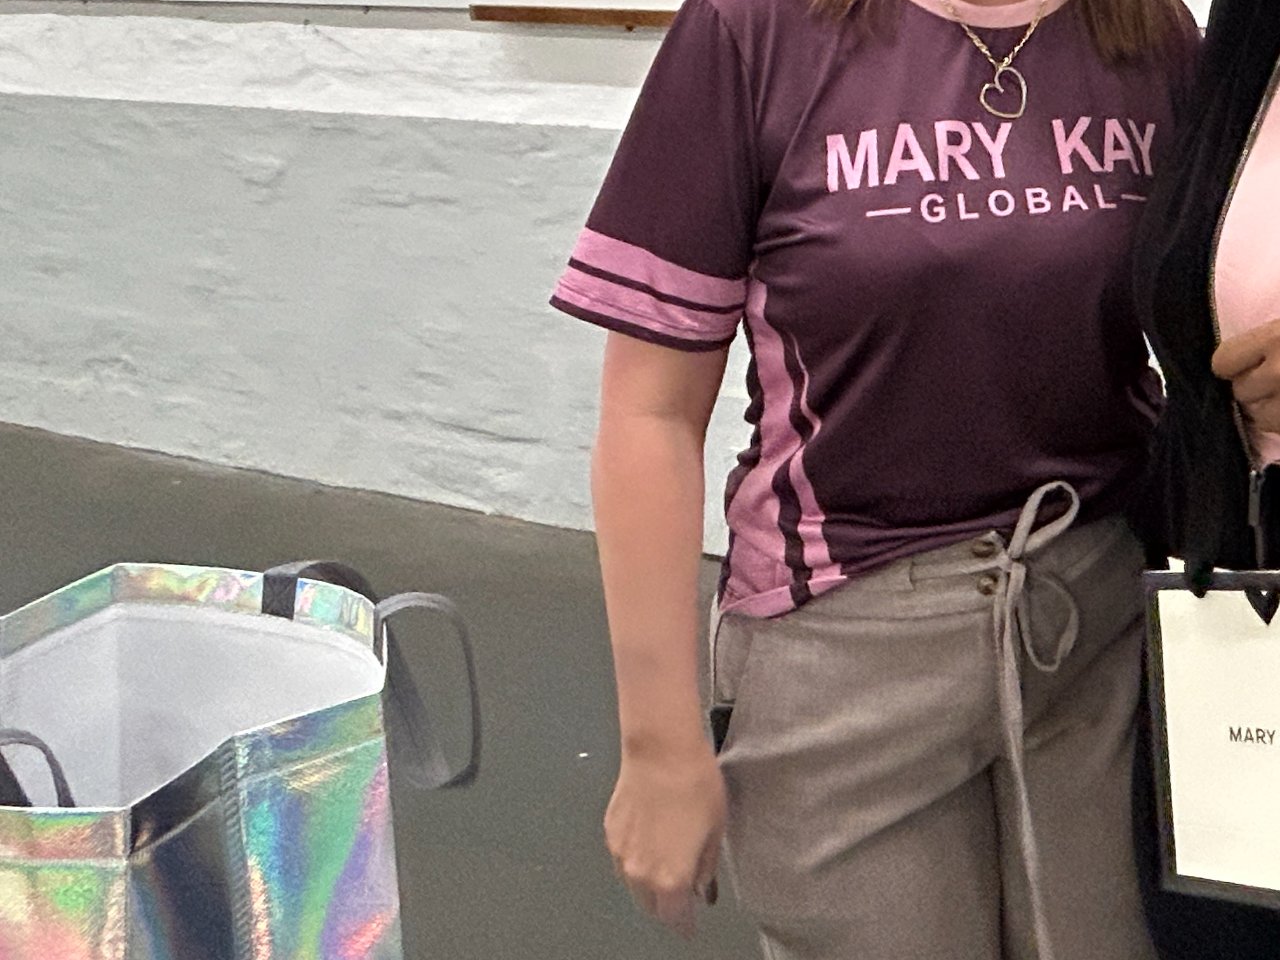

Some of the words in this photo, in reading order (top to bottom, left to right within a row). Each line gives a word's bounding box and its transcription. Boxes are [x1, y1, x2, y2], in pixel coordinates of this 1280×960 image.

[826, 120, 1013, 192] MARY
[1051, 116, 1156, 176] KAY
[920, 184, 1118, 223] GLOBAL
[1229, 726, 1276, 745] MARY
